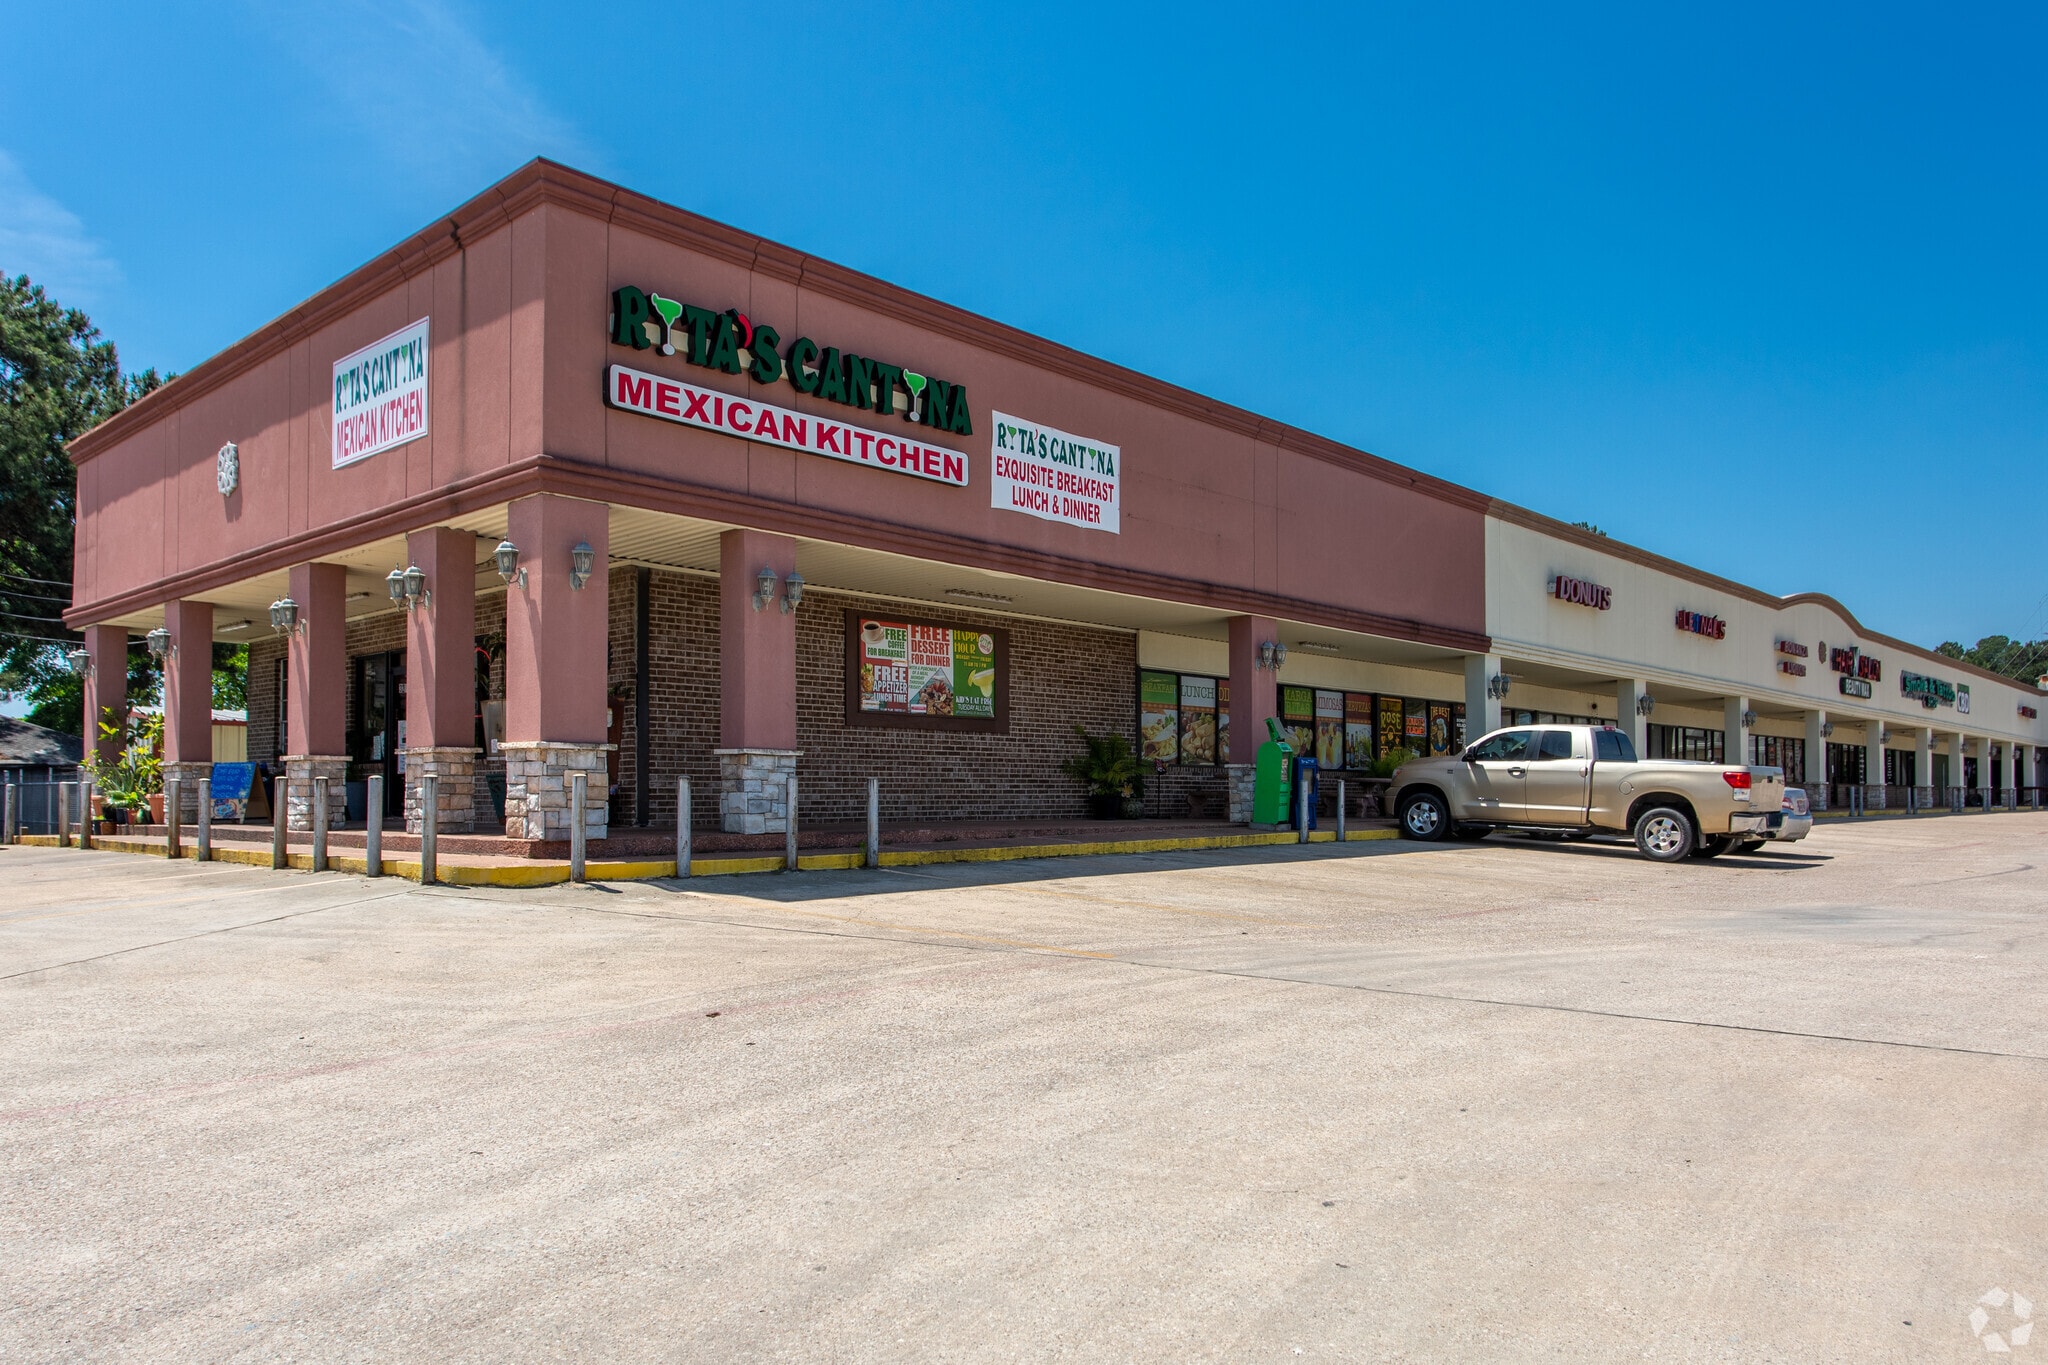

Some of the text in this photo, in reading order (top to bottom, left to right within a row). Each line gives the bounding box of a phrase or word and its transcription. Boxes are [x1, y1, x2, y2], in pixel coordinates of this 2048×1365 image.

[336, 387, 423, 460] MEXICAN KITCHEN
[618, 372, 963, 482] MEXICAN KITCHEN
[996, 455, 1115, 503] EXQUISITE BREAKFAST
[1012, 485, 1101, 524] LUNCH & DINNER
[1559, 575, 1613, 611] DONUTS
[885, 628, 907, 641] FREE
[911, 624, 950, 642] FREE
[954, 630, 979, 642] HAPPY
[867, 647, 906, 659] FOR BREAKFAST
[911, 640, 950, 656] DESSERT
[954, 642, 976, 654] HOUR
[911, 653, 950, 667] FOR DINNER
[874, 665, 907, 682] FREE
[873, 680, 908, 693] APPETIZER
[1180, 685, 1215, 699] LUNCH
[873, 692, 907, 703] LUNCH TIME
